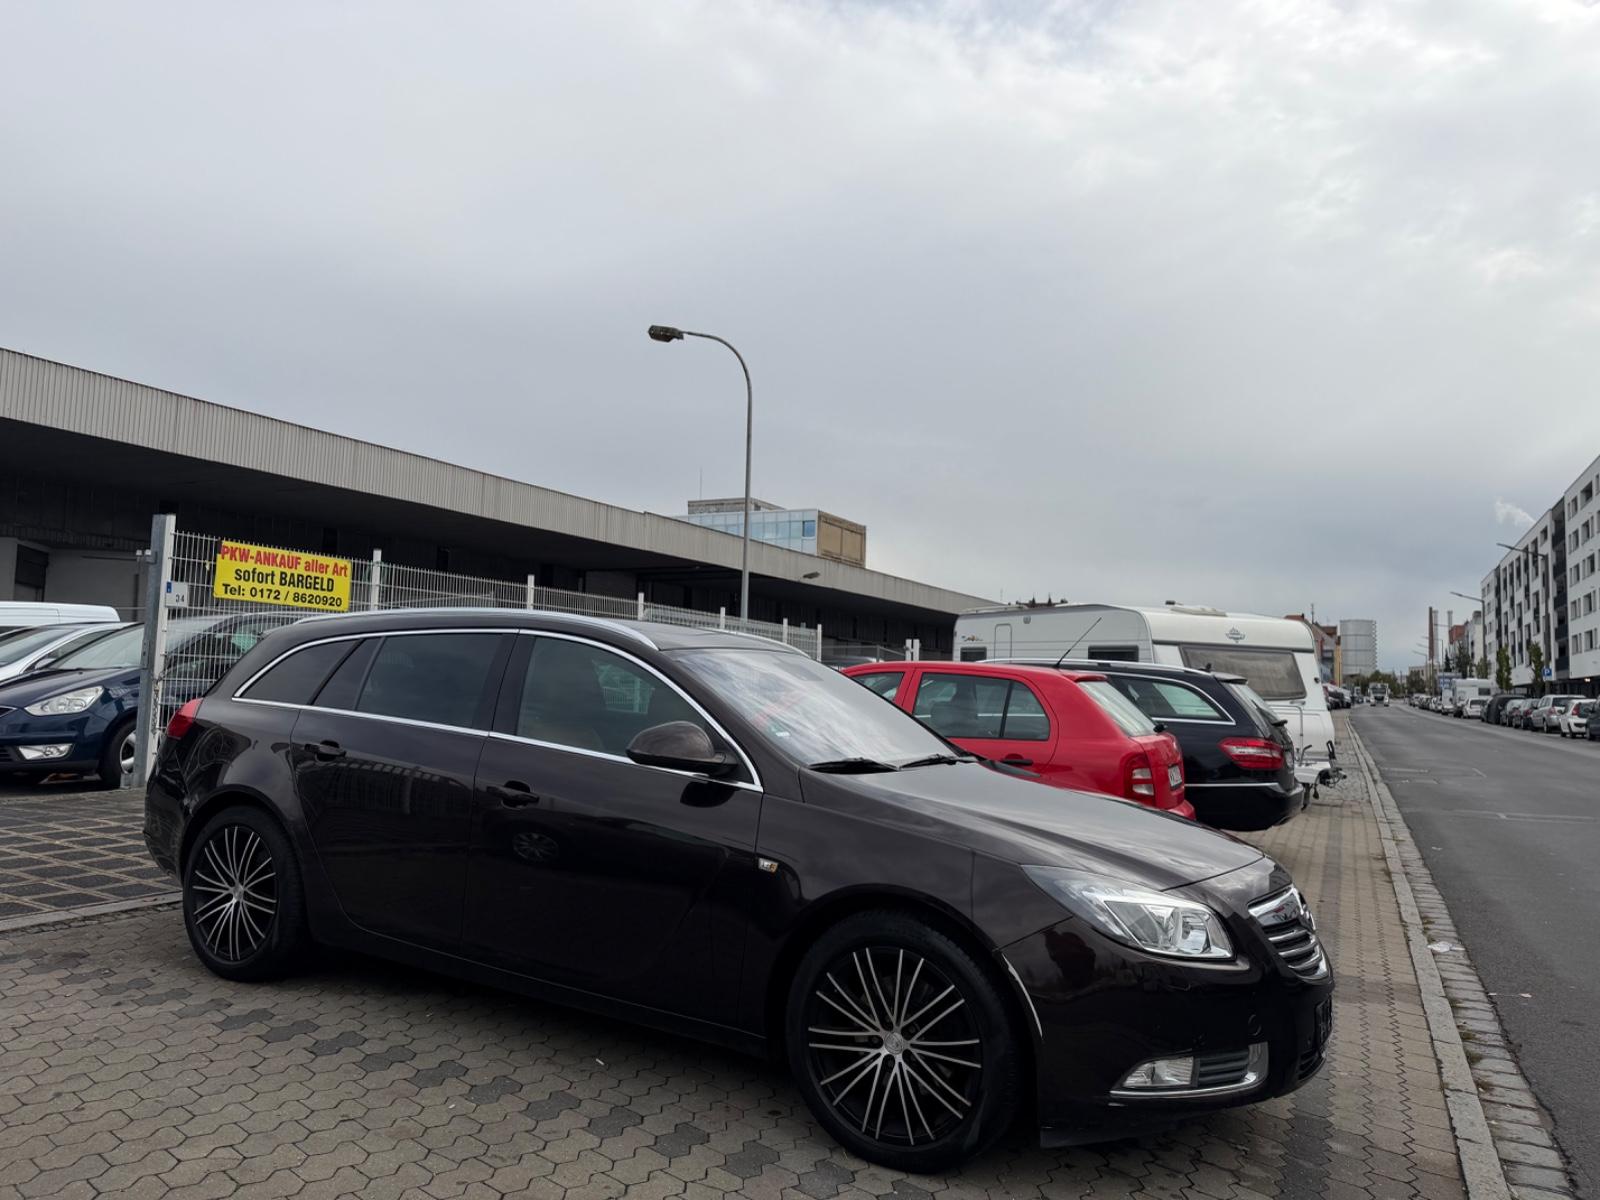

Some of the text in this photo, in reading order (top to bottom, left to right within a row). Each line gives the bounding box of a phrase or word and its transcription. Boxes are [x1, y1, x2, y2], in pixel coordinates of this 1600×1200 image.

[221, 545, 348, 578] PKW-ANKAUF aller Art
[234, 567, 334, 592] sofort BARGELD
[222, 583, 343, 607] Tel: 0172 / 8620920
